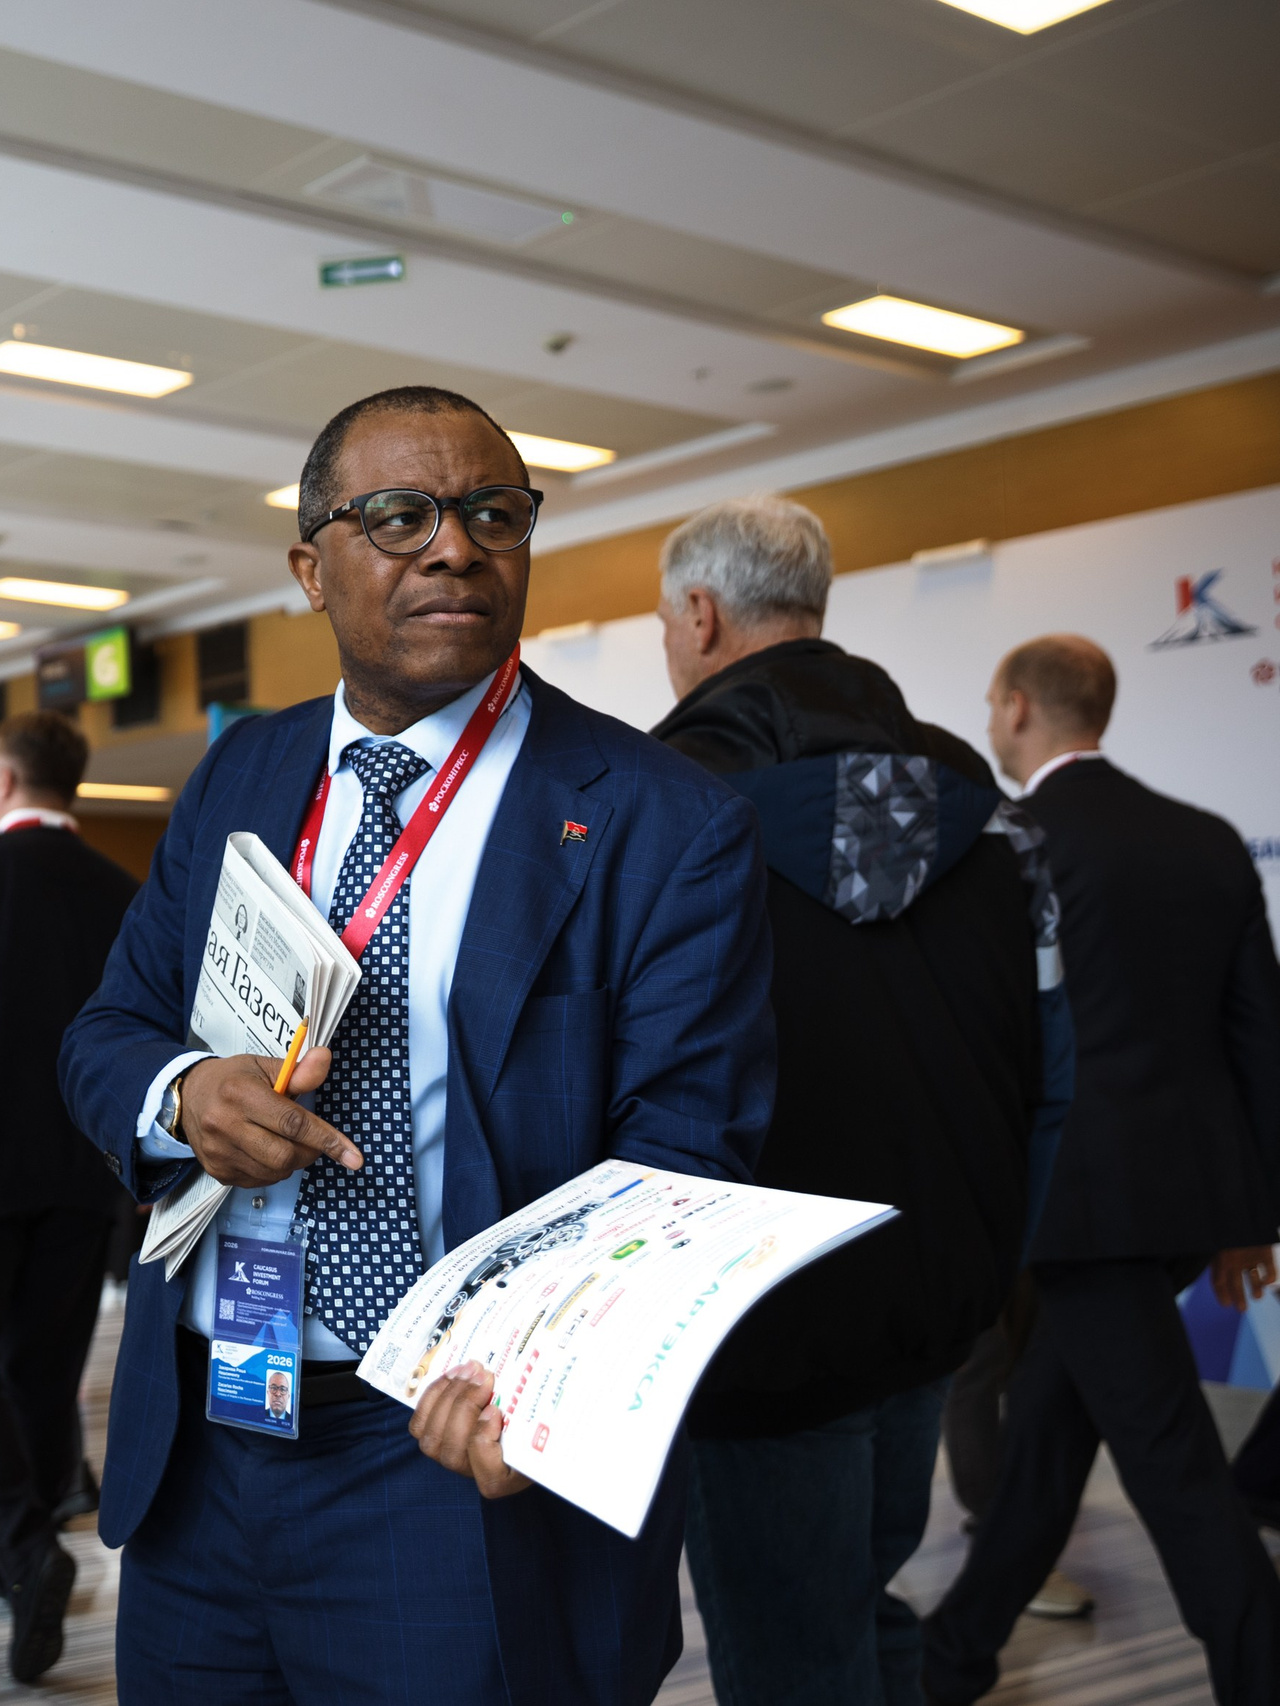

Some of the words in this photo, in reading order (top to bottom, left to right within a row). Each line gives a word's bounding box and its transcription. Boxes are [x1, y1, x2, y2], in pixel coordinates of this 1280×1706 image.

[434, 749, 470, 804] РОСКОНГРЕСС
[296, 846, 308, 888] РОСКОНГ
[371, 851, 410, 910] ROSCONGRESS
[224, 1241, 238, 1249] 2026
[252, 1271, 281, 1281] INVESTMENT
[253, 1263, 278, 1273] CAUCASUS
[251, 1288, 284, 1300] ROSCONGRESS
[252, 1279, 269, 1287] FORUM
[495, 1328, 520, 1378] MANITOU
[628, 1281, 720, 1412] АРТЭКСА
[267, 1354, 293, 1368] 2026
[550, 1357, 578, 1406] FENDT
